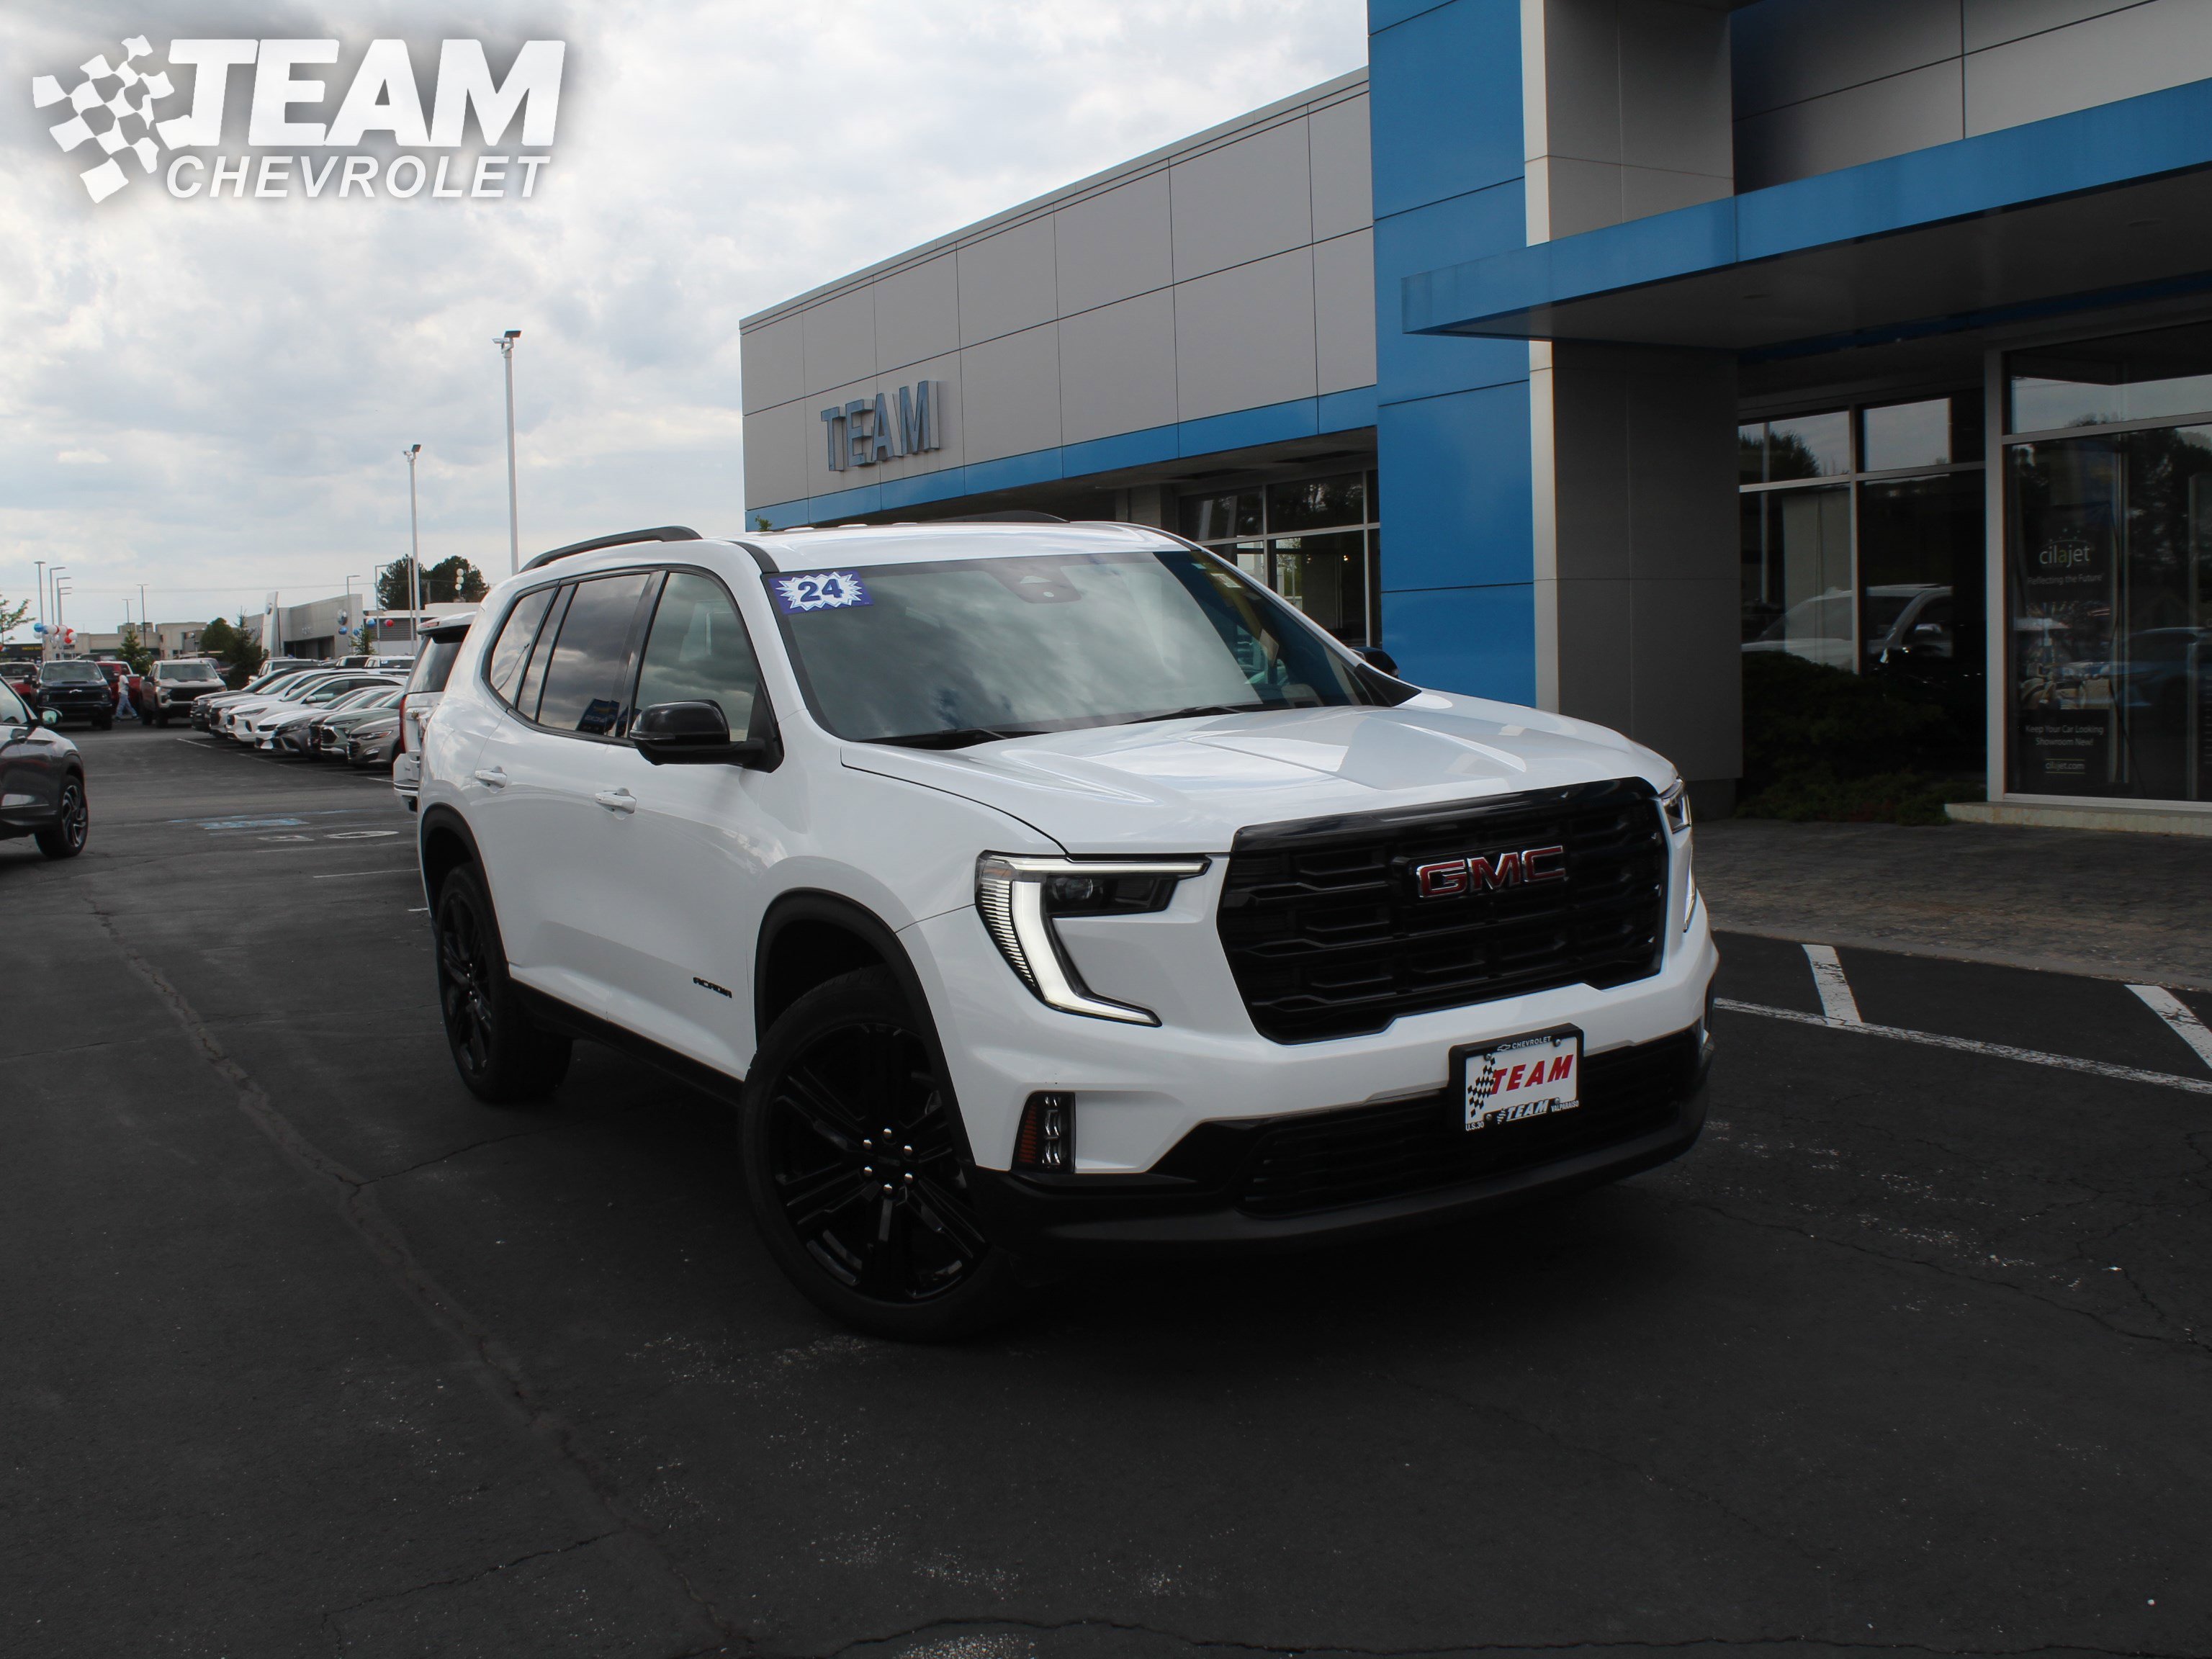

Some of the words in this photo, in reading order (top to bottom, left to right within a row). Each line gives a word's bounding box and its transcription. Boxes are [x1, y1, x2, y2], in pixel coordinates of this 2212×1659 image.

[820, 379, 940, 472] TEAM
[2039, 544, 2090, 567] cilajet
[797, 578, 844, 602] 24
[2075, 726, 2104, 734] Looking
[1416, 845, 1566, 897] GMC
[1512, 1035, 1552, 1049] CHEVROLET
[1490, 1054, 1574, 1095] TEAM
[1506, 1100, 1548, 1120] TEAM
[1551, 1100, 1579, 1112] VALPARAISO
